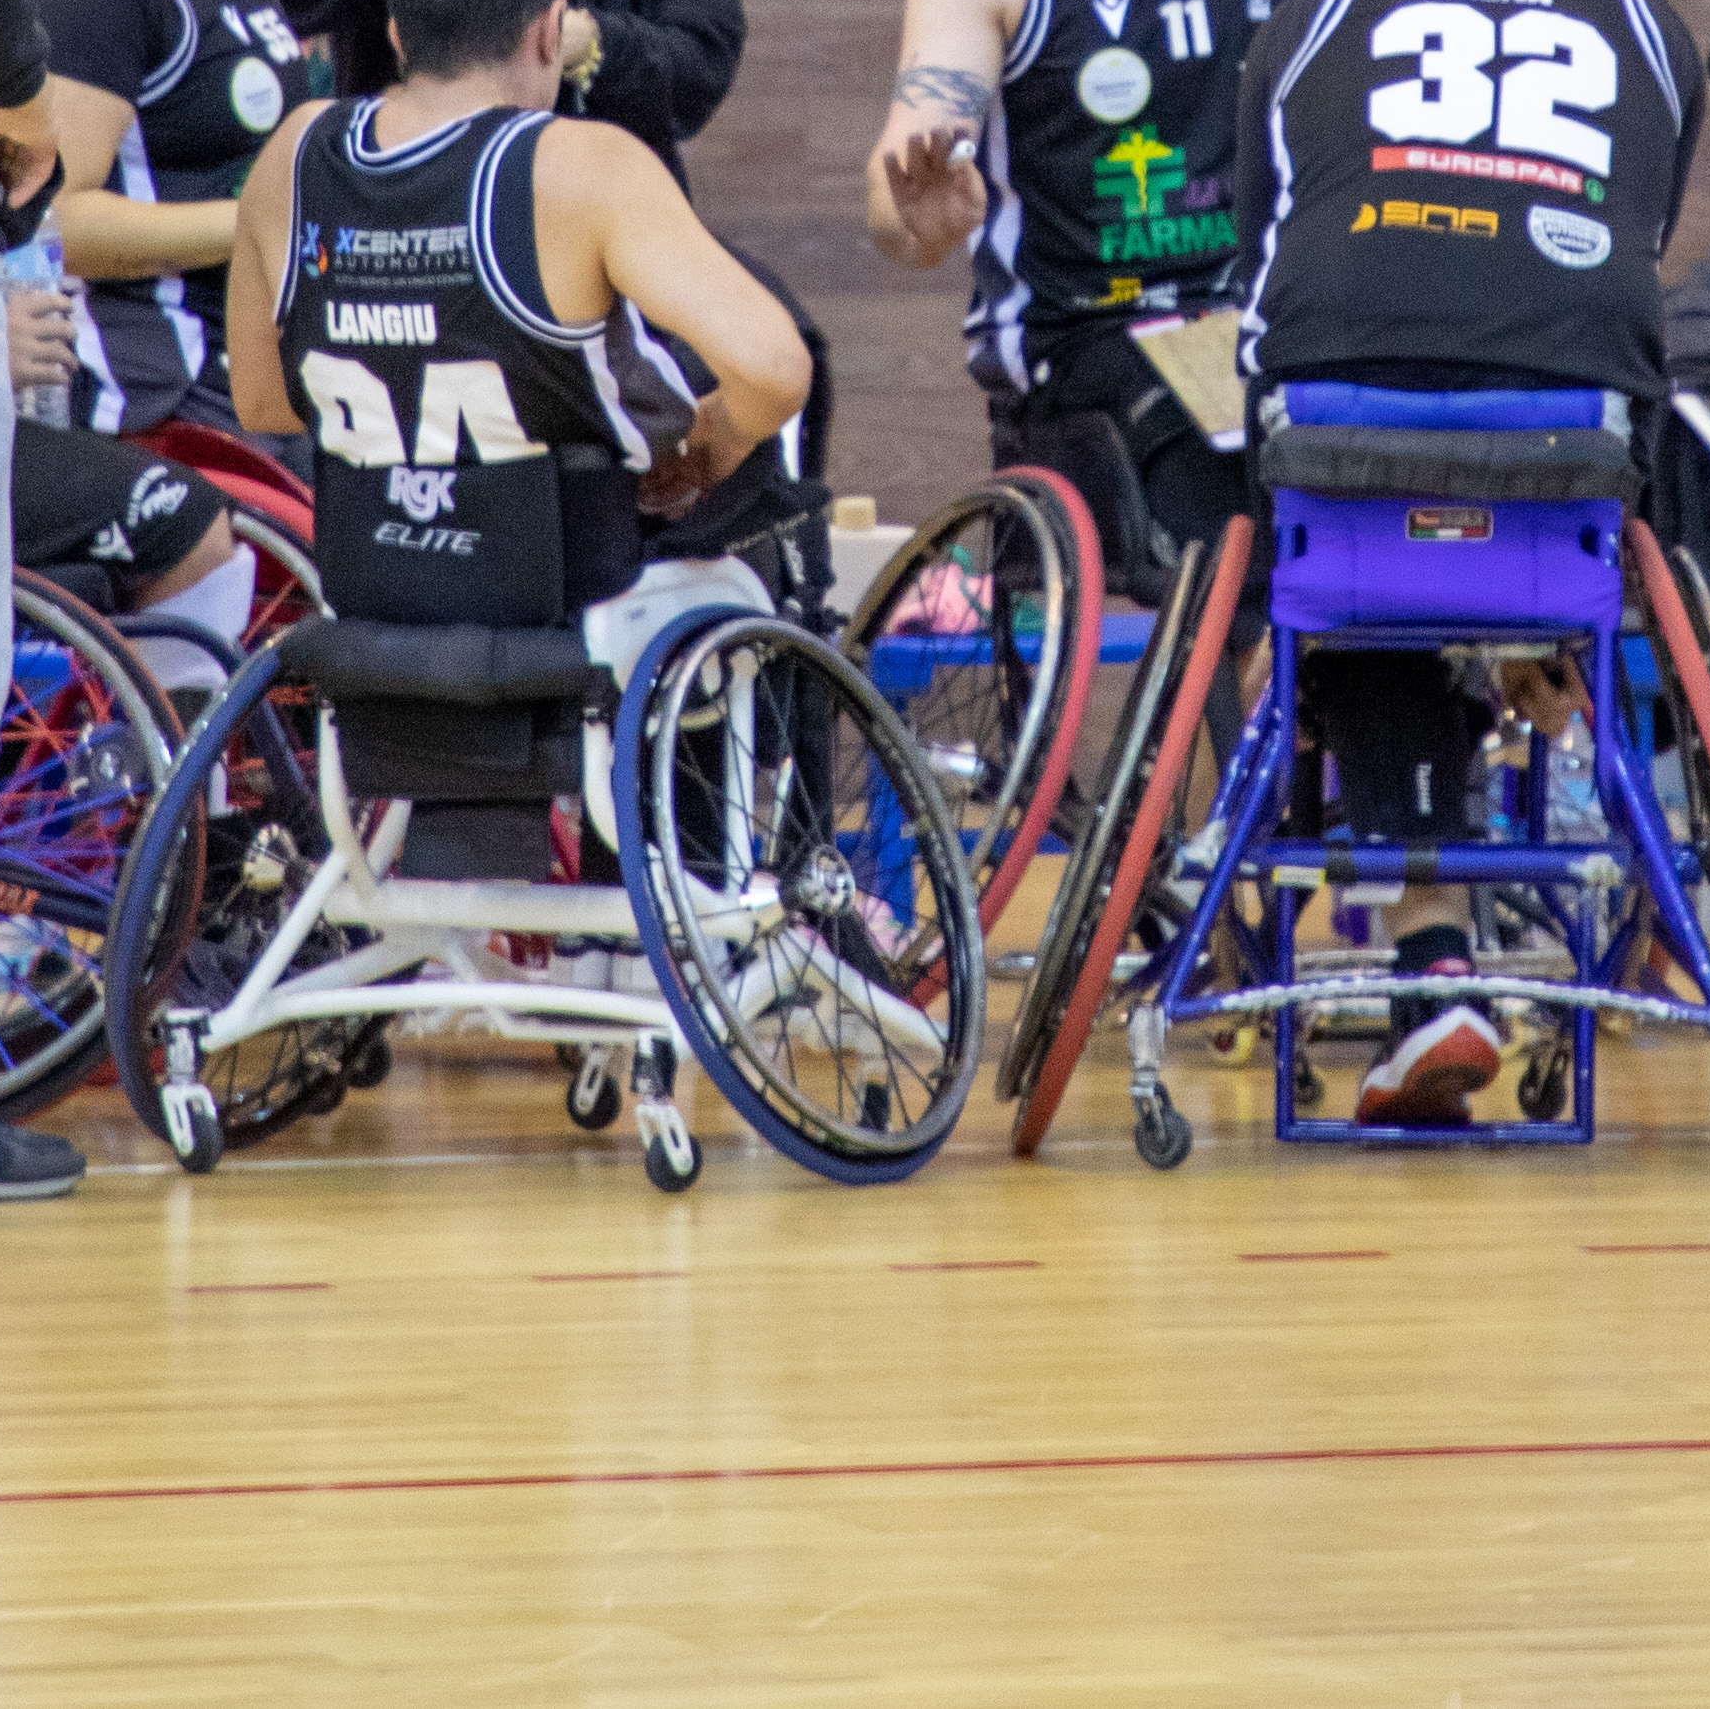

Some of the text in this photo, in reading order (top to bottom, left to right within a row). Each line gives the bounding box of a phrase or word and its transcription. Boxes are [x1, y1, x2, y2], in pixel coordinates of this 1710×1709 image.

[1369, 0, 1619, 178] 32
[1405, 149, 1582, 192] EUROSPAR
[335, 225, 468, 254] XCENTER
[1100, 211, 1237, 263] FARMA
[326, 301, 438, 345] LANGIU
[374, 521, 482, 556] ELITE
